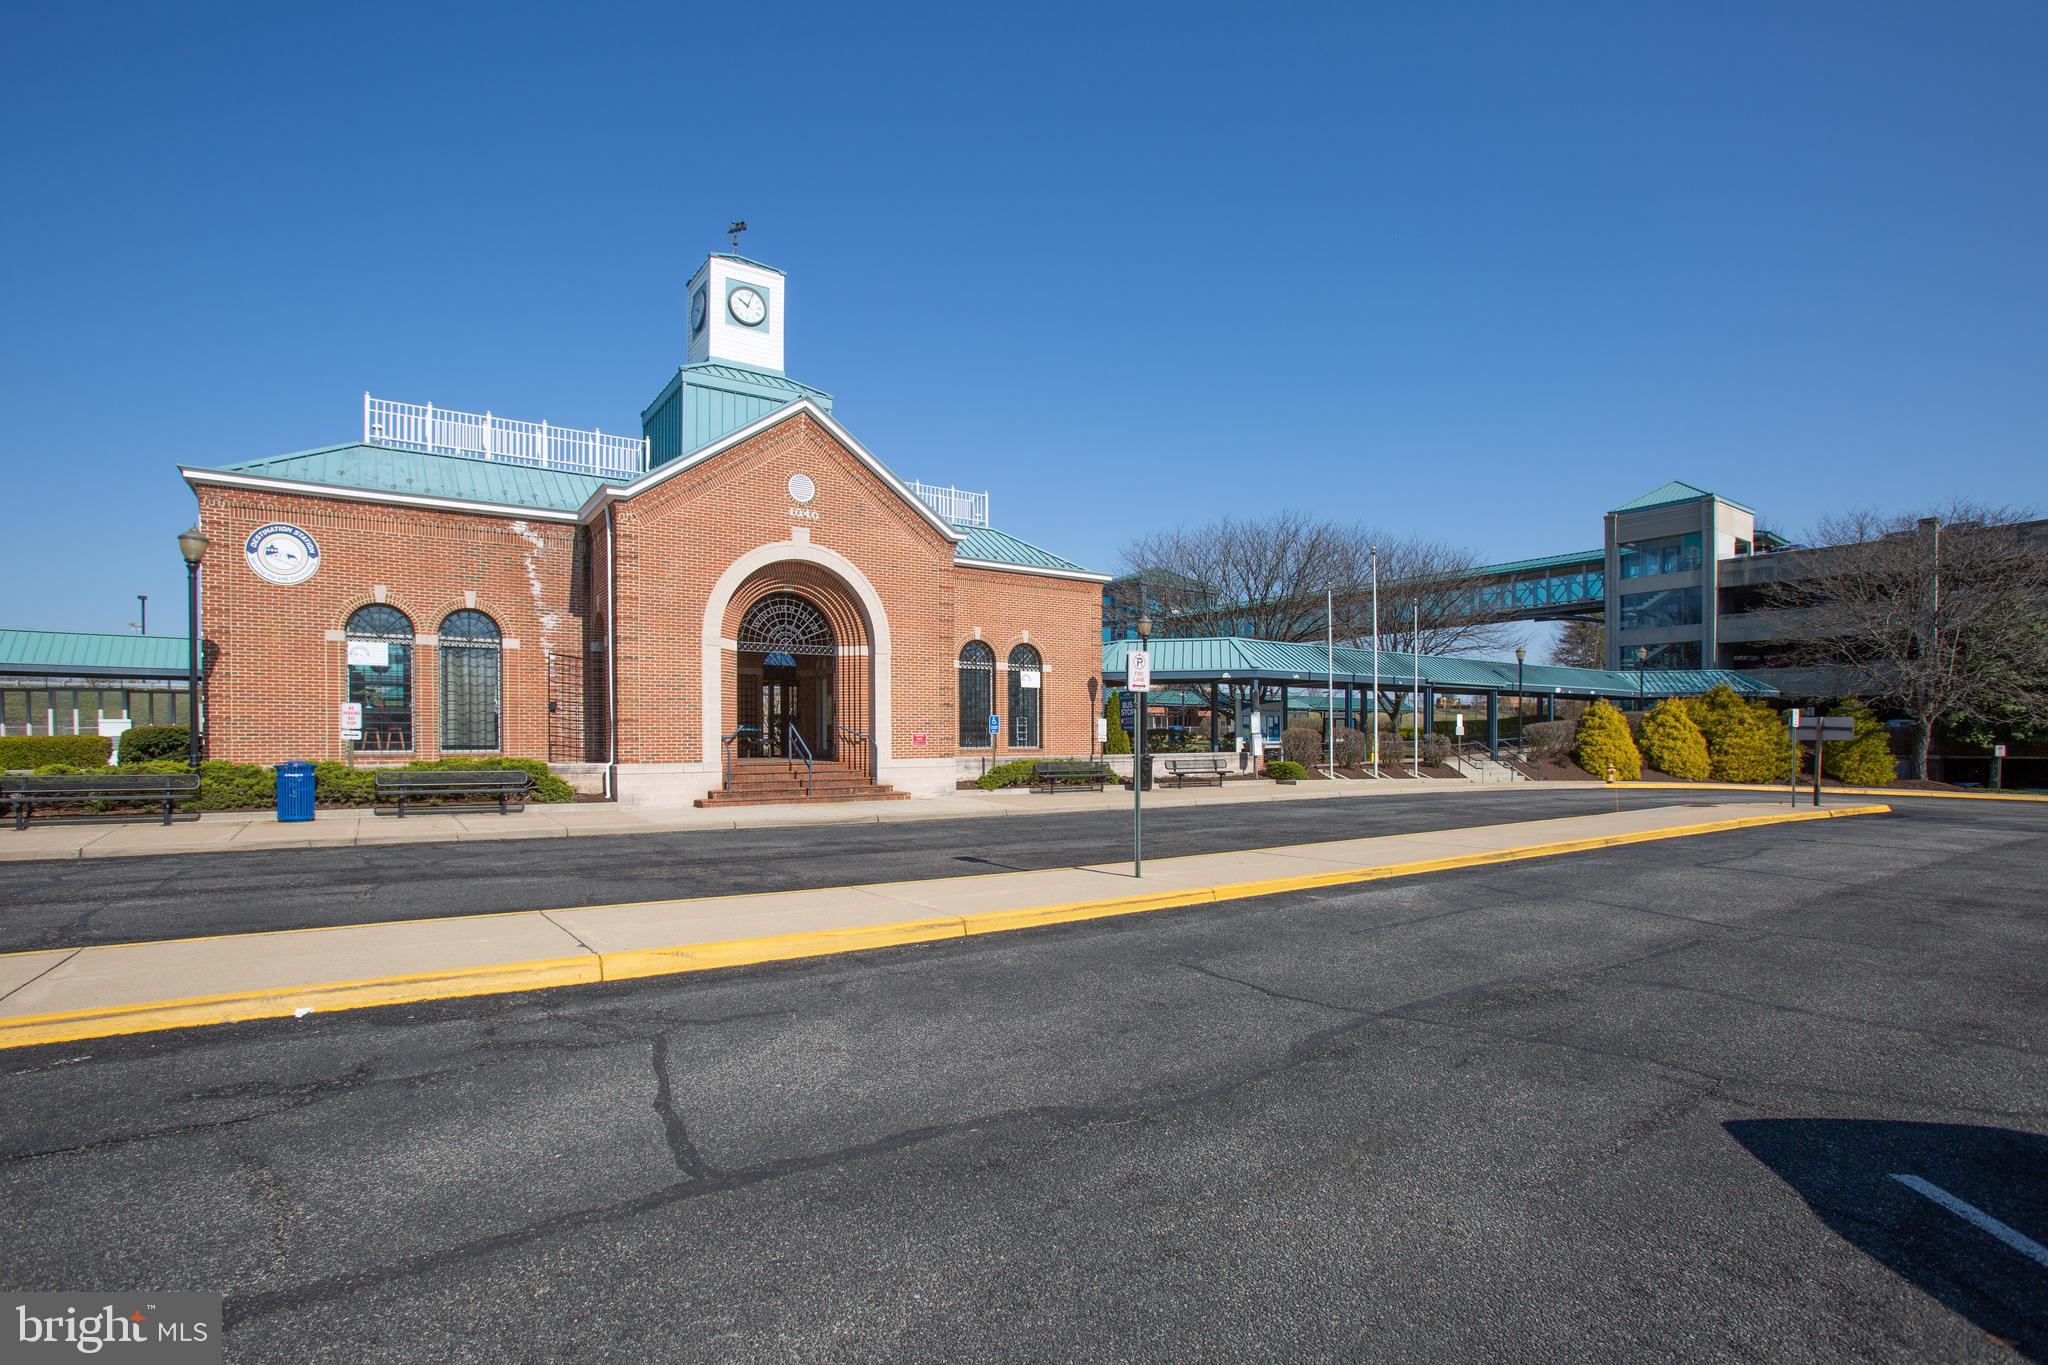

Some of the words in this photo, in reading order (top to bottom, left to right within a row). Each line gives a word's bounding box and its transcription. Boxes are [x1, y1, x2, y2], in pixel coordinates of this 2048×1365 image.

[790, 507, 818, 520] 1040
[250, 525, 293, 548] DESTINATION
[293, 529, 316, 554] STATION
[1121, 701, 1133, 709] BUS
[1121, 708, 1134, 716] STOP
